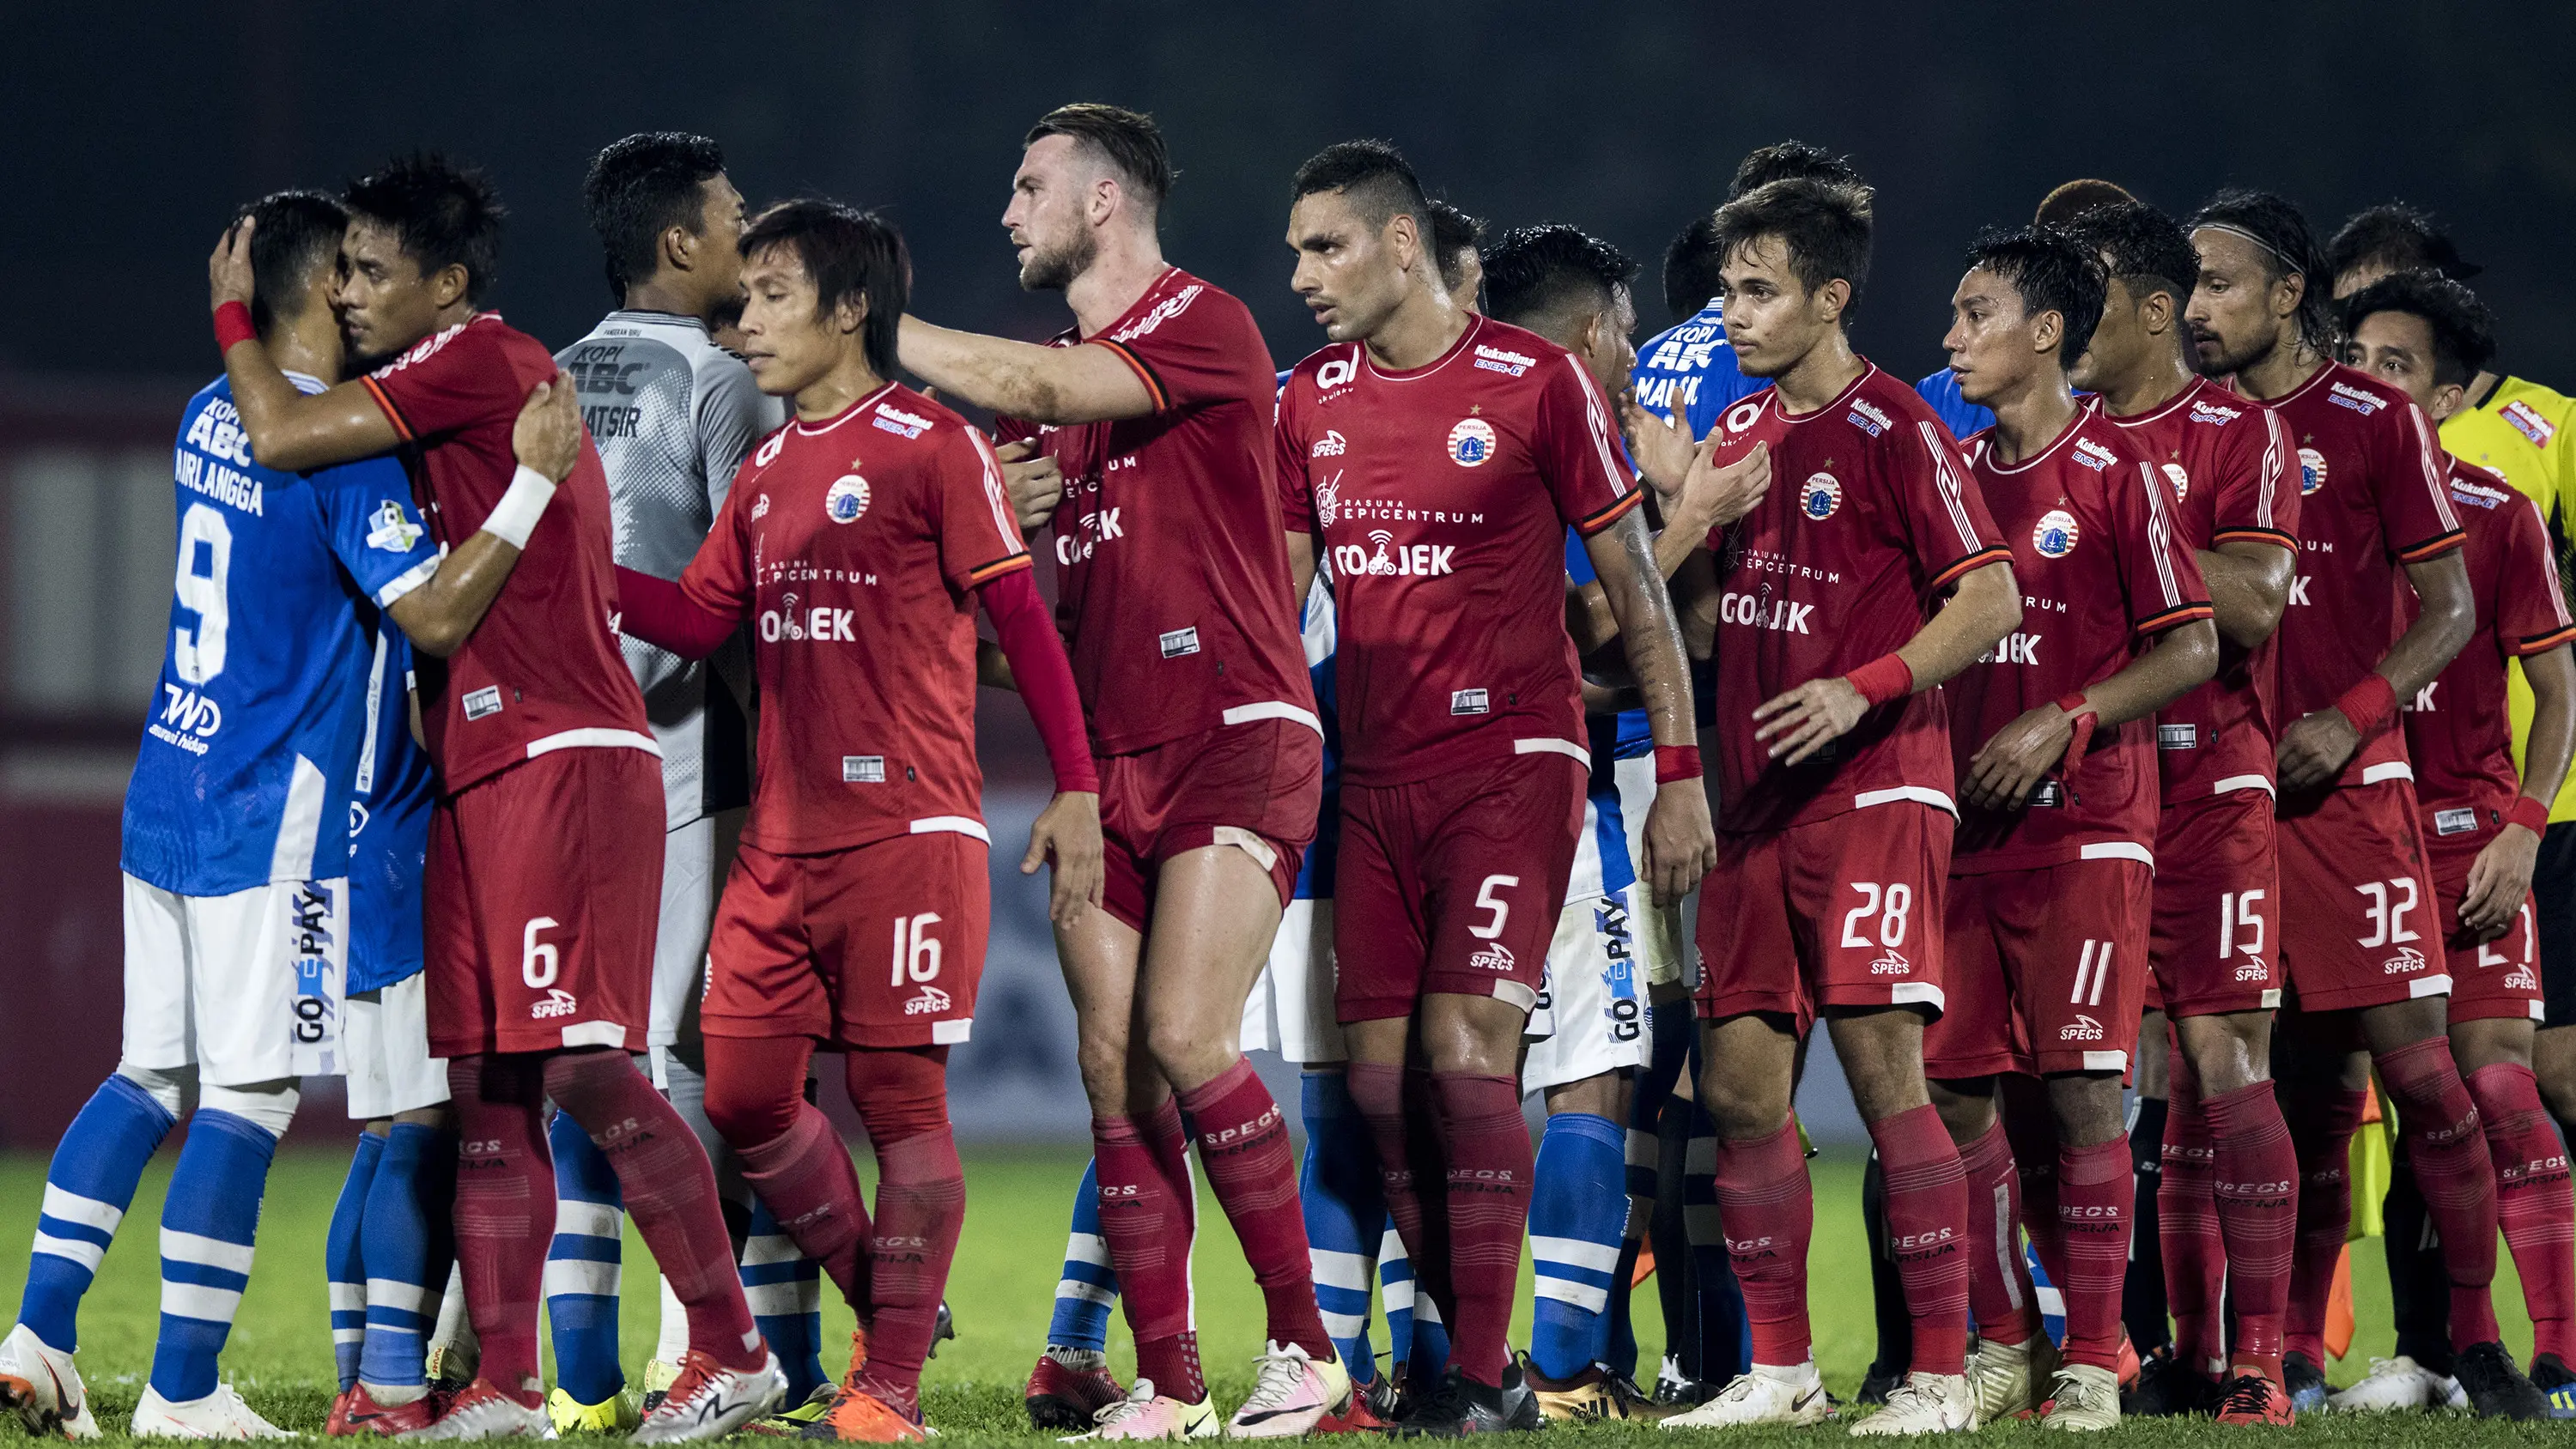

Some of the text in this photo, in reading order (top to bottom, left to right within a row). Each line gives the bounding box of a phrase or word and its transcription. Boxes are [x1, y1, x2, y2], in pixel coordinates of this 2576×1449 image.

[1671, 326, 1717, 344] KOPI
[574, 345, 625, 362] KOPI
[1473, 344, 1536, 368] KukuBima
[568, 361, 646, 396] ABC
[1473, 359, 1526, 378] ENER-G!
[1318, 385, 1355, 405] akulaku
[2327, 393, 2376, 417] ENER-G!
[2330, 380, 2389, 411] KukuBima
[1847, 411, 1882, 439] ENER-G!
[1850, 397, 1894, 432] KukuBima
[186, 413, 254, 468] ABC
[1312, 441, 1346, 458] SPECS
[2075, 435, 2118, 466] KukuBima
[2071, 450, 2107, 472] ENER-G!
[175, 448, 264, 518] AIRLANGGA
[1812, 476, 1836, 486] PERSIJA
[2451, 476, 2511, 503] KukuBima
[1344, 508, 1484, 524] EPICENTRUM
[1345, 499, 1405, 509] RASUNA
[1747, 558, 1840, 585] EPICETRUM
[174, 500, 233, 687] 9
[760, 606, 856, 643] OJEK
[176, 734, 209, 756] hidup
[1467, 874, 1519, 940] 5
[1839, 882, 1912, 948] 28
[2353, 876, 2422, 949] 32
[2220, 888, 2266, 960] 15
[524, 915, 560, 990] 6
[891, 911, 943, 987] 16
[1469, 954, 1514, 972] SPECS
[1870, 960, 1911, 976] SPECS
[2070, 938, 2114, 1006] 11
[2234, 968, 2268, 981] SPECS
[2384, 956, 2426, 975] SPECS
[2503, 976, 2538, 991] SPECS
[531, 1000, 577, 1020] SPECS
[904, 996, 951, 1016] SPECS
[2059, 1028, 2104, 1041] SPECS
[1205, 1102, 1281, 1144] SPECS
[2214, 1179, 2291, 1195] SPECS
[1892, 1227, 1954, 1248] PECS
